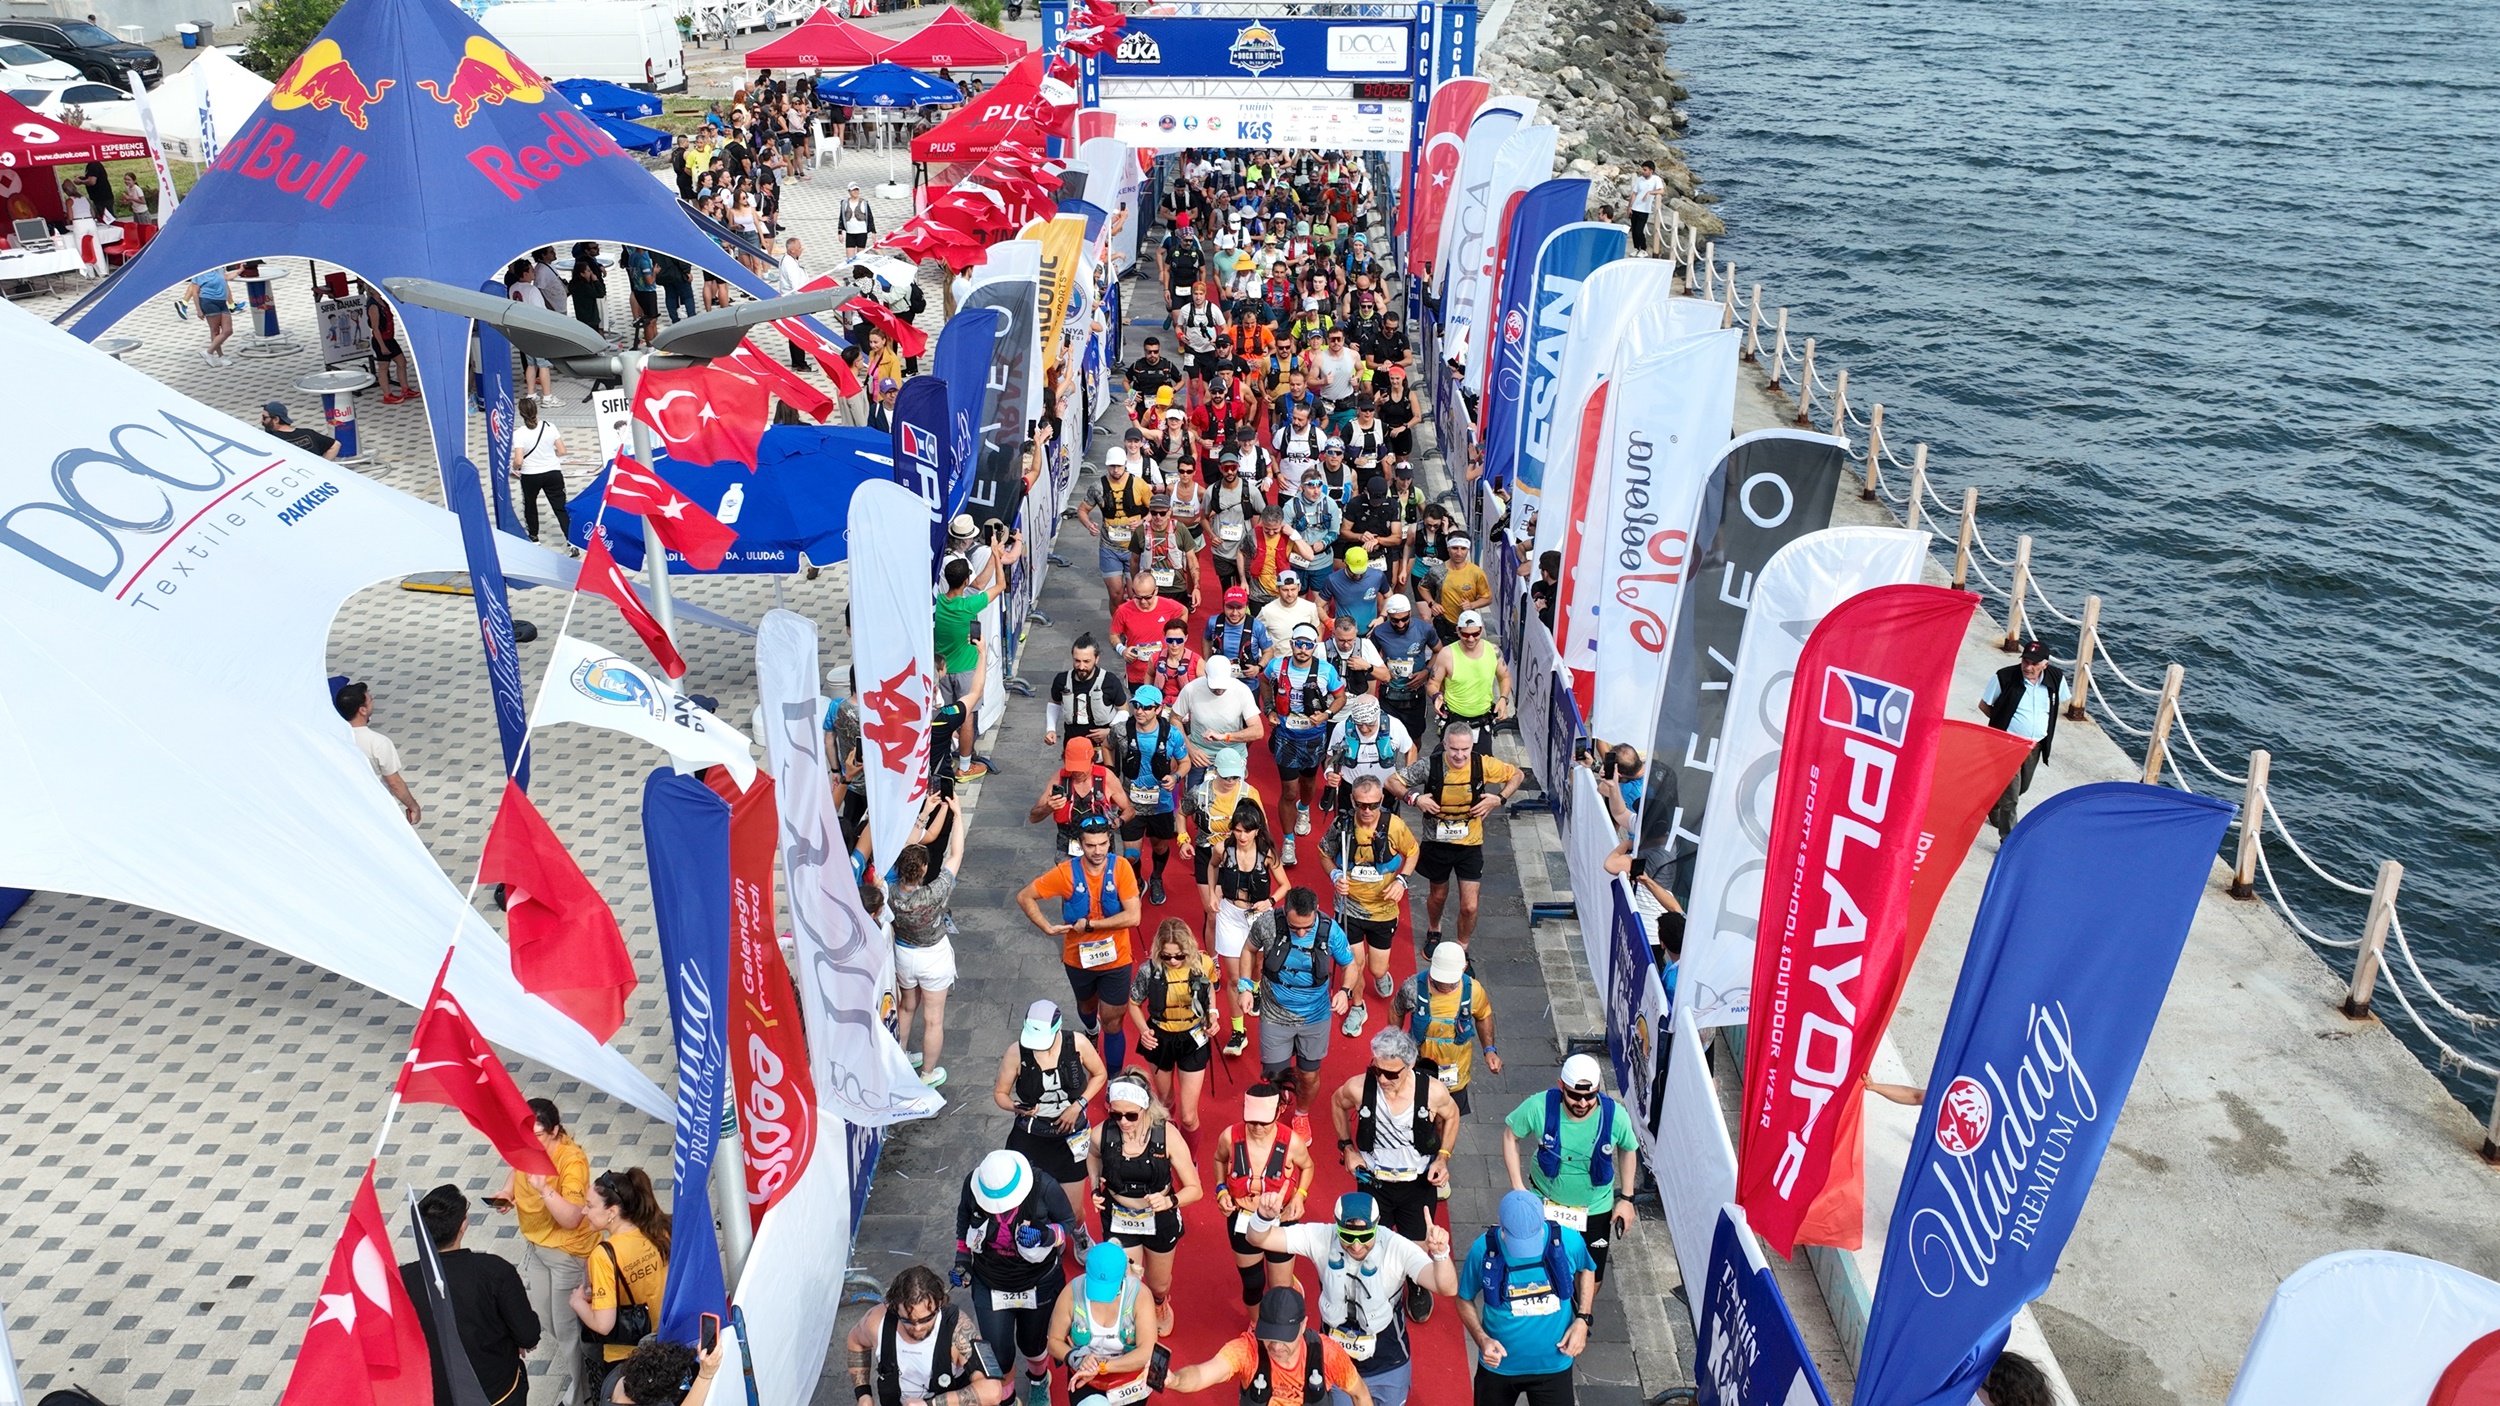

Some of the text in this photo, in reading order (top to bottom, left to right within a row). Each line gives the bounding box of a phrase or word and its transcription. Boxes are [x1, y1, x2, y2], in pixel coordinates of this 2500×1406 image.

[1117, 43, 1160, 59] BUKA
[1339, 34, 1397, 53] DOCA
[1418, 5, 1431, 103] DOCA
[1453, 14, 1464, 78] DOCA
[1364, 83, 1409, 97] 9:00:22
[34, 150, 90, 161] www.durak.com
[101, 142, 145, 152] EXPERIENCE
[120, 149, 146, 157] DURAK
[930, 143, 956, 153] PLUS
[1238, 121, 1273, 144] KOŞ
[238, 122, 368, 209] Bull
[466, 112, 593, 202] Red
[1526, 274, 1585, 463] ESAN
[1, 408, 272, 592] DOCA
[276, 480, 341, 528] PAKKENS
[131, 464, 317, 612] Textile Tech
[746, 550, 785, 562] ULUDAĞ
[1291, 717, 1309, 727] 3198
[1444, 828, 1463, 836] 3261
[749, 883, 761, 932] tadı
[734, 877, 756, 994] Geleneğin
[1089, 949, 1110, 961] 3196
[1758, 764, 1820, 1129] SPORT&SCHOOL&OUTDOOR WEAR
[1771, 736, 1898, 1201] PLAYOFF
[689, 1061, 716, 1169] PREMIUM
[743, 1032, 792, 1206] bidaa
[1907, 998, 2099, 1300] Uludağ
[2009, 1108, 2079, 1253] PREMIUM
[1121, 1219, 1146, 1229] 3031
[1553, 1209, 1579, 1223] 3124
[1002, 1291, 1029, 1301] 3215
[1721, 1258, 1761, 1368] TARİHİN
